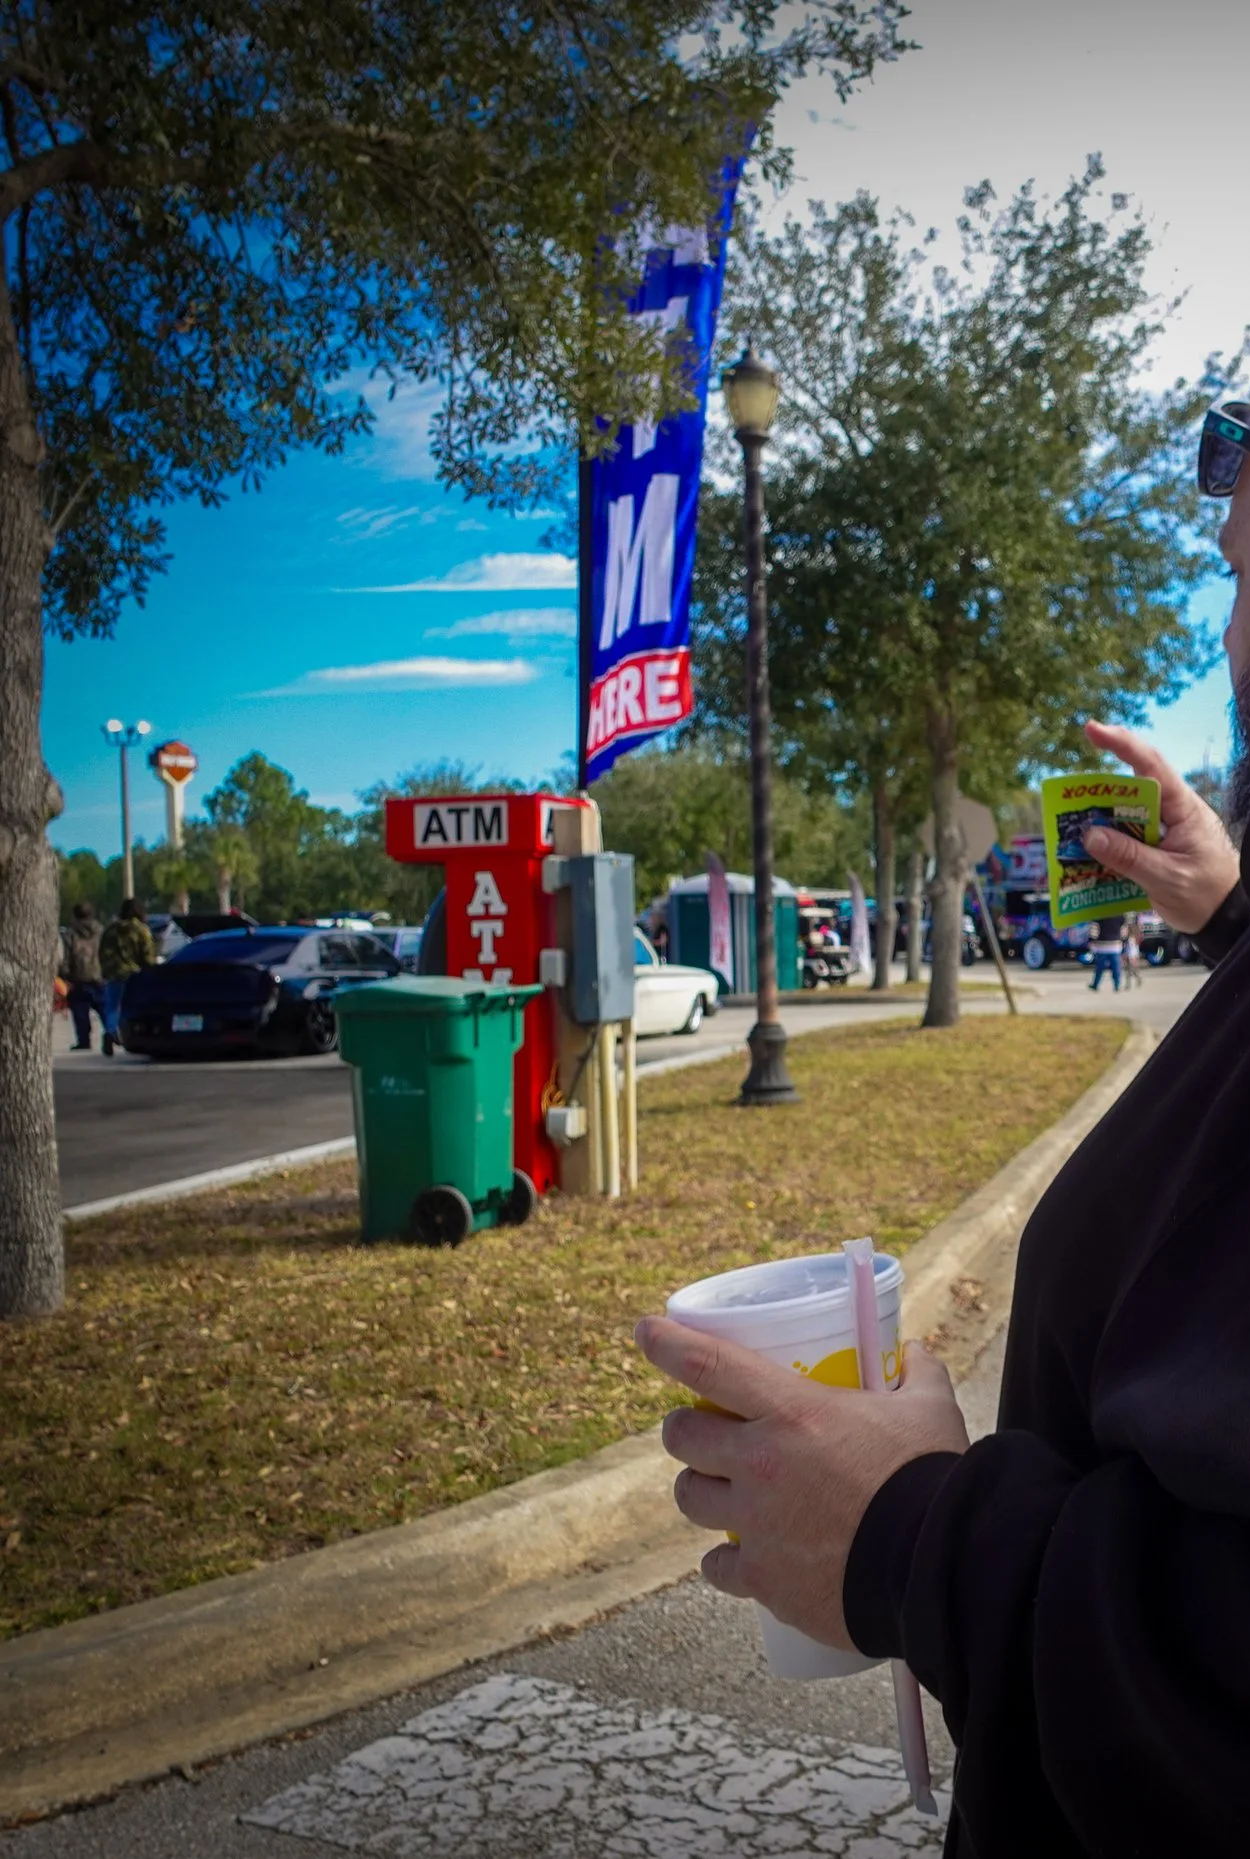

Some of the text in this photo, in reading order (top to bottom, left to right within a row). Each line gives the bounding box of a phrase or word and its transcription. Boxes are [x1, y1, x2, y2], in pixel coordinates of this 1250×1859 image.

[587, 659, 682, 750] HERE
[1062, 783, 1139, 799] VENDOR
[422, 807, 501, 843] ATM
